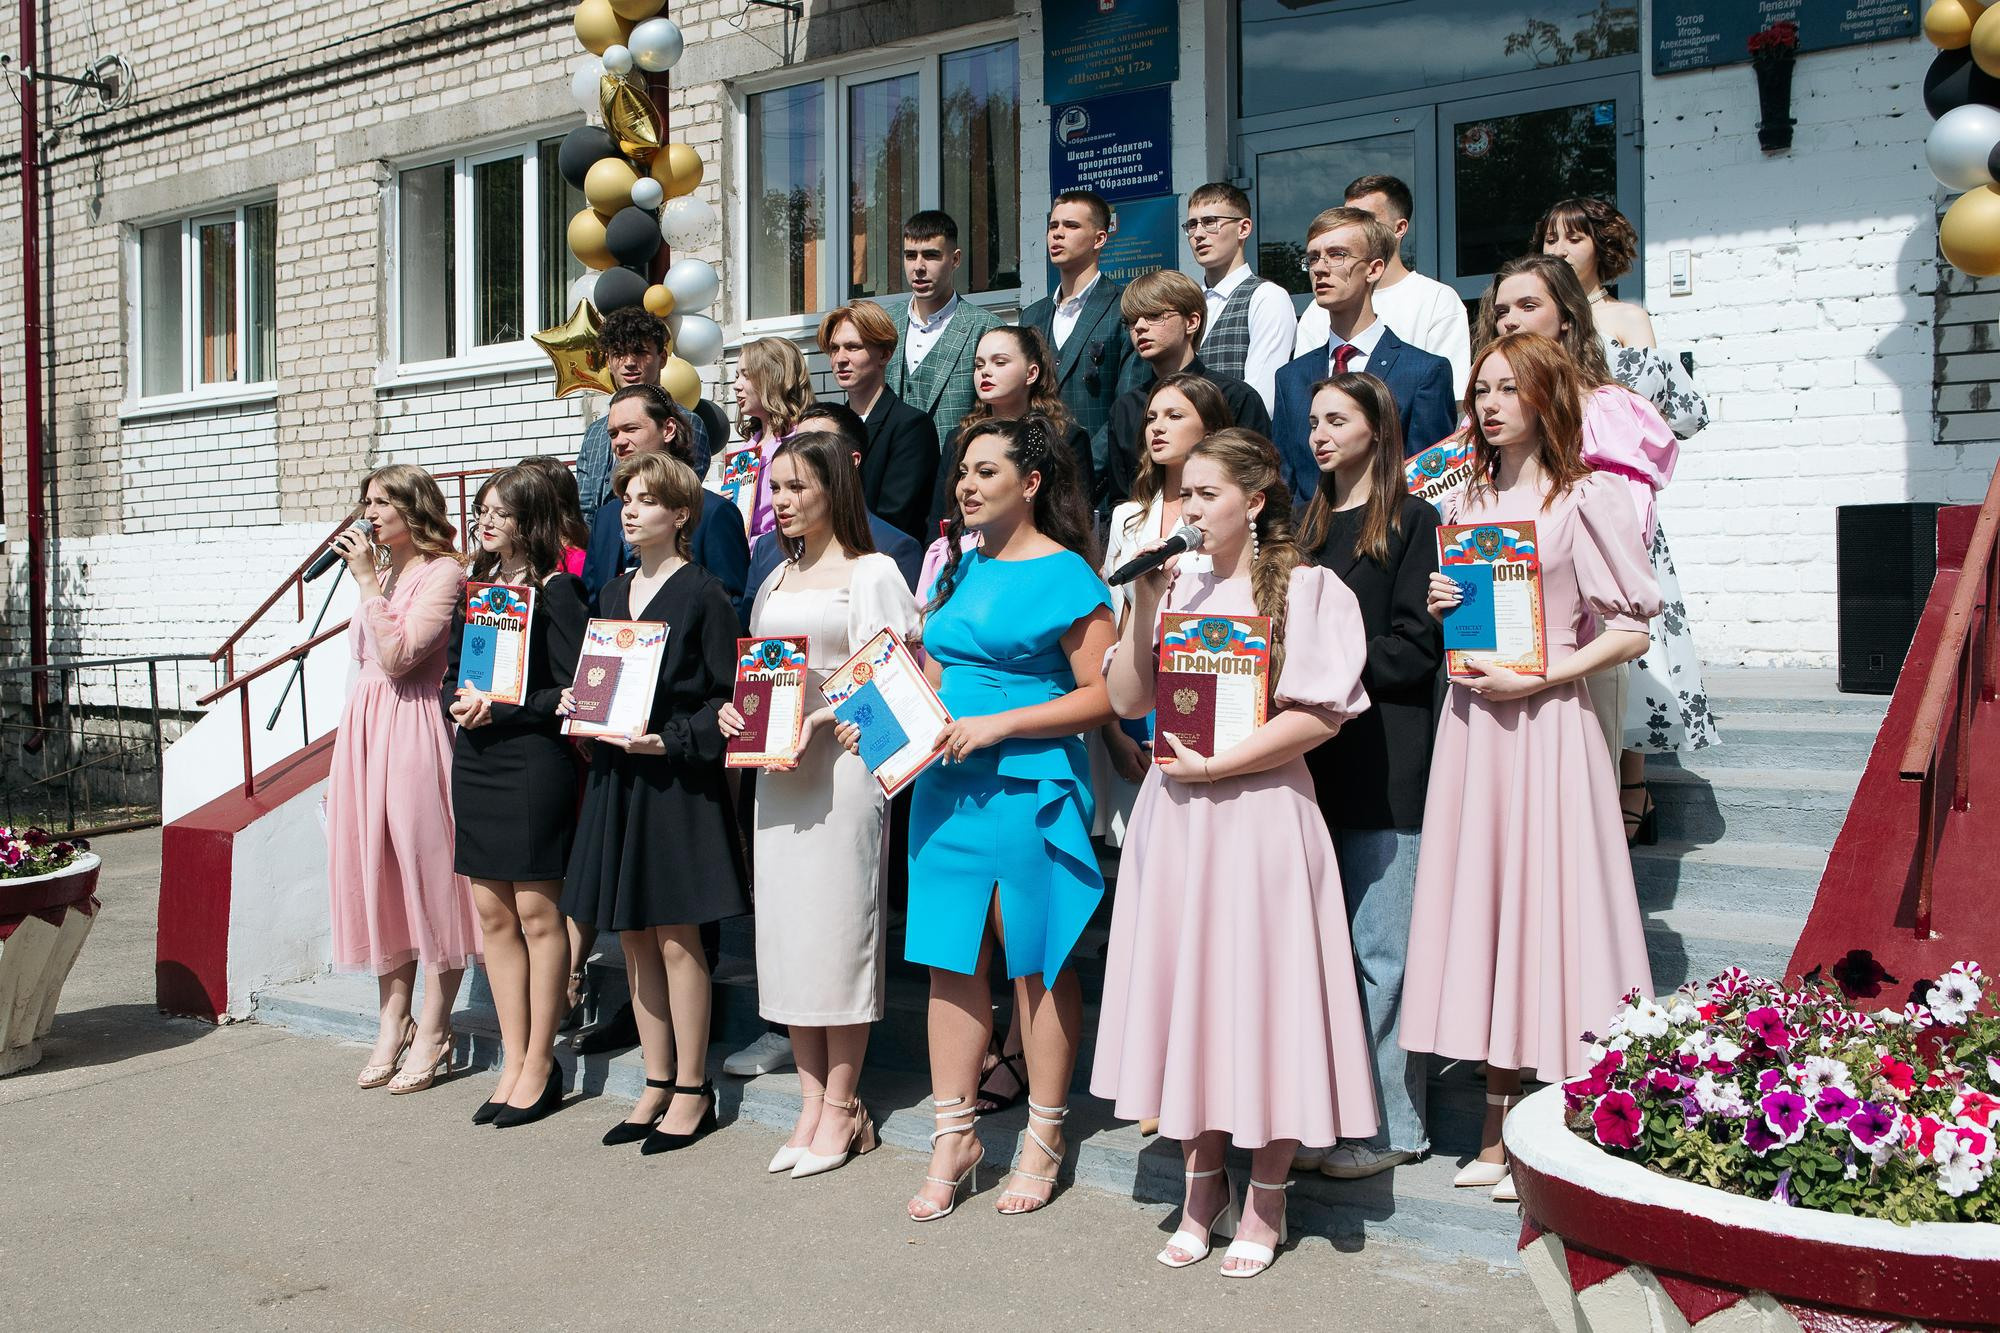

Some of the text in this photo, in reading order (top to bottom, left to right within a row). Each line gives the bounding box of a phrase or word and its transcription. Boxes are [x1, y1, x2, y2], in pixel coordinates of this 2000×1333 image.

[1675, 14, 1704, 27] Зотов
[1678, 26, 1702, 37] Игорь
[1660, 33, 1720, 50] Александрович
[1128, 61, 1152, 74] 172»
[1067, 149, 1095, 162] Школа
[1102, 140, 1153, 156] победитель
[1078, 152, 1142, 171] приоритетного
[1078, 164, 1143, 182] национального
[1095, 170, 1164, 190] "Образование"
[1127, 264, 1162, 278] ЦЕНТР
[475, 615, 518, 632] ГРАМОТА
[1177, 654, 1252, 676] ГРАМОТА
